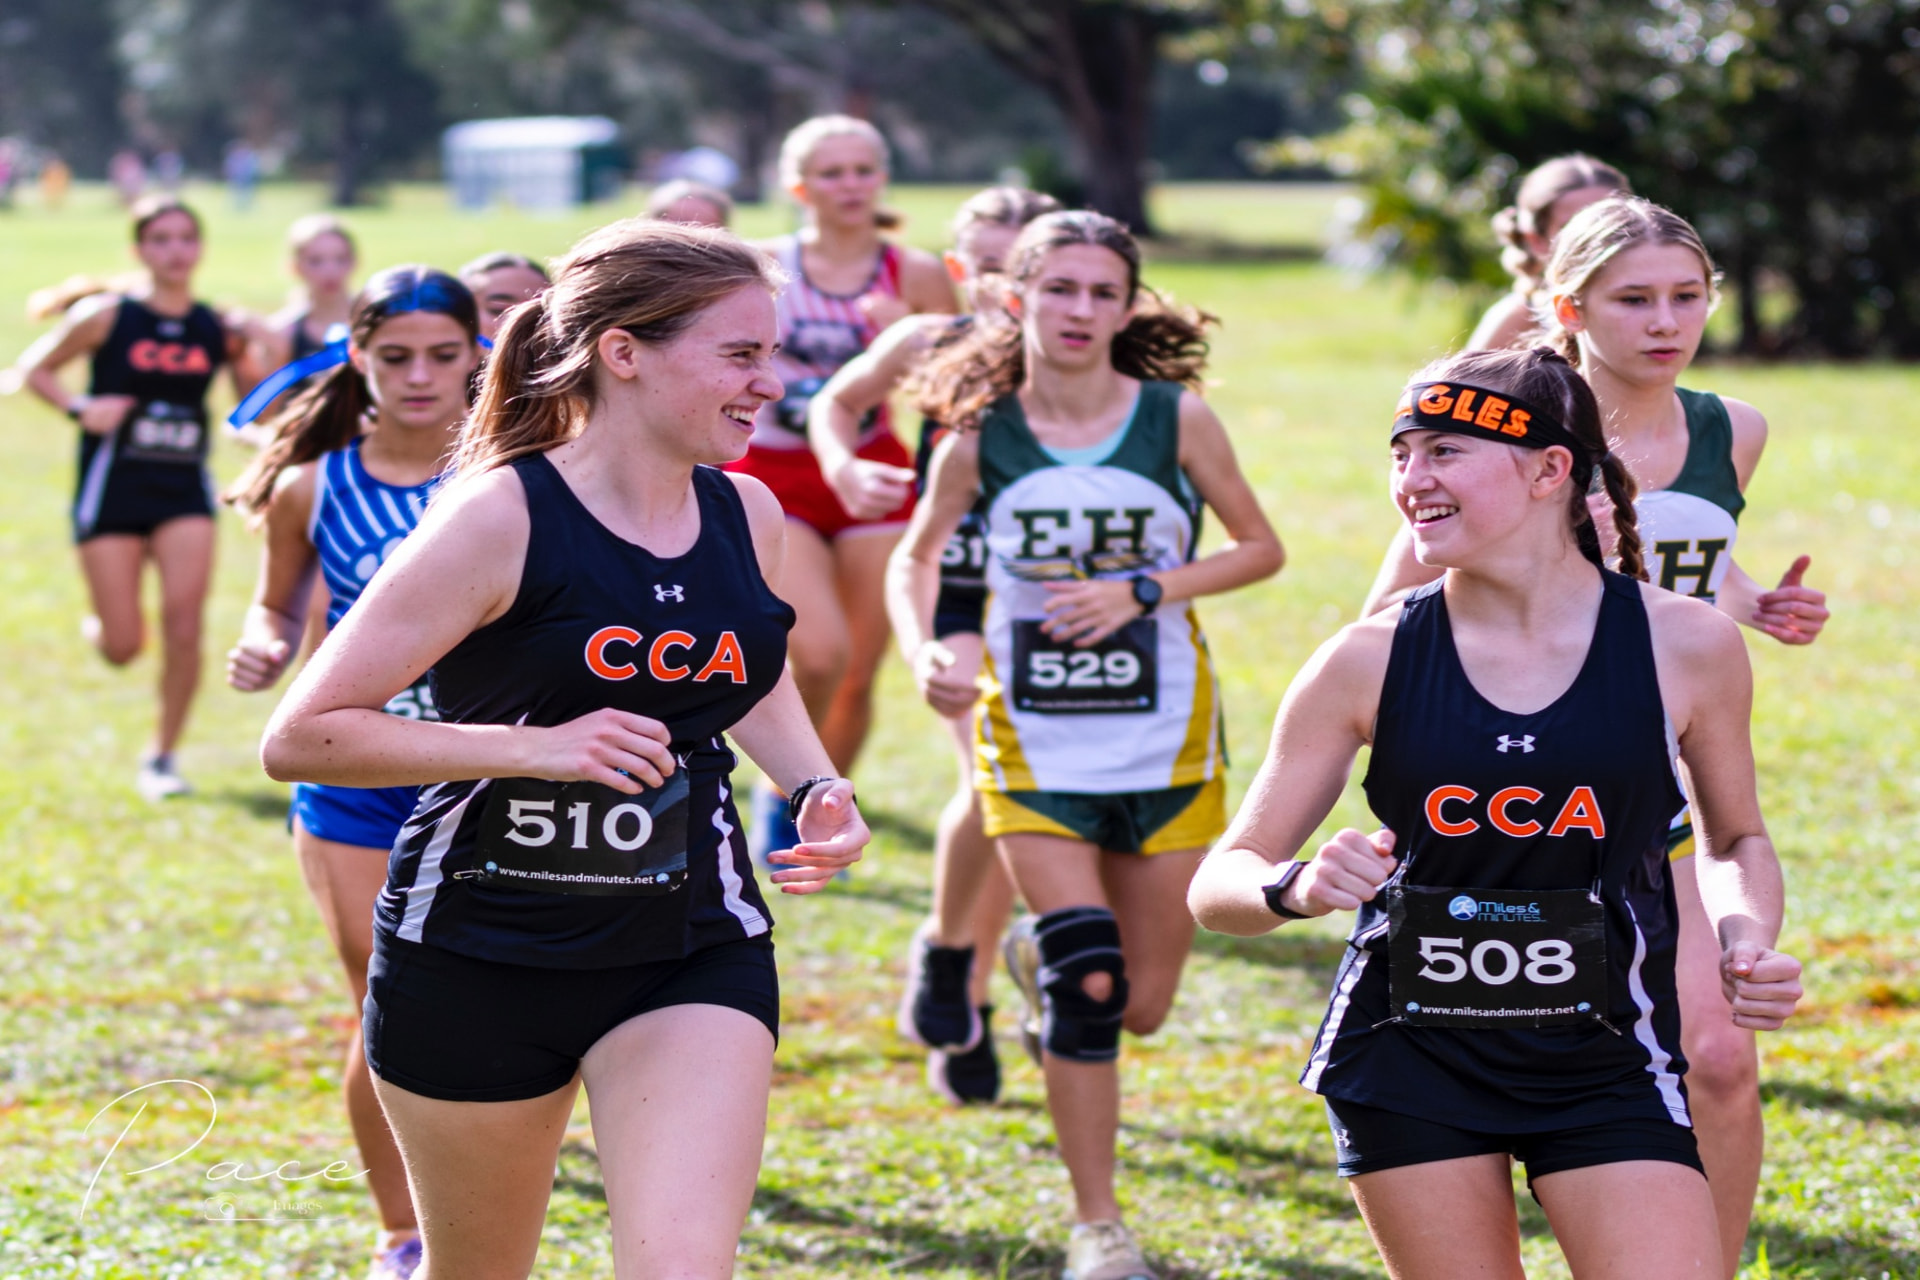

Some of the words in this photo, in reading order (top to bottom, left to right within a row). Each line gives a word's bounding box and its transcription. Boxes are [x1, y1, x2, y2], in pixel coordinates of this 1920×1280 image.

[128, 338, 211, 374] CCA
[1013, 508, 1154, 559] EH
[584, 625, 748, 684] CCA
[1029, 651, 1141, 688] 529
[504, 798, 654, 852] 510
[1425, 784, 1606, 839] CCA
[499, 866, 654, 884] www.milesandminutes.net
[1417, 936, 1576, 985] 508
[1421, 1005, 1575, 1018] www.milesandminutes.net
